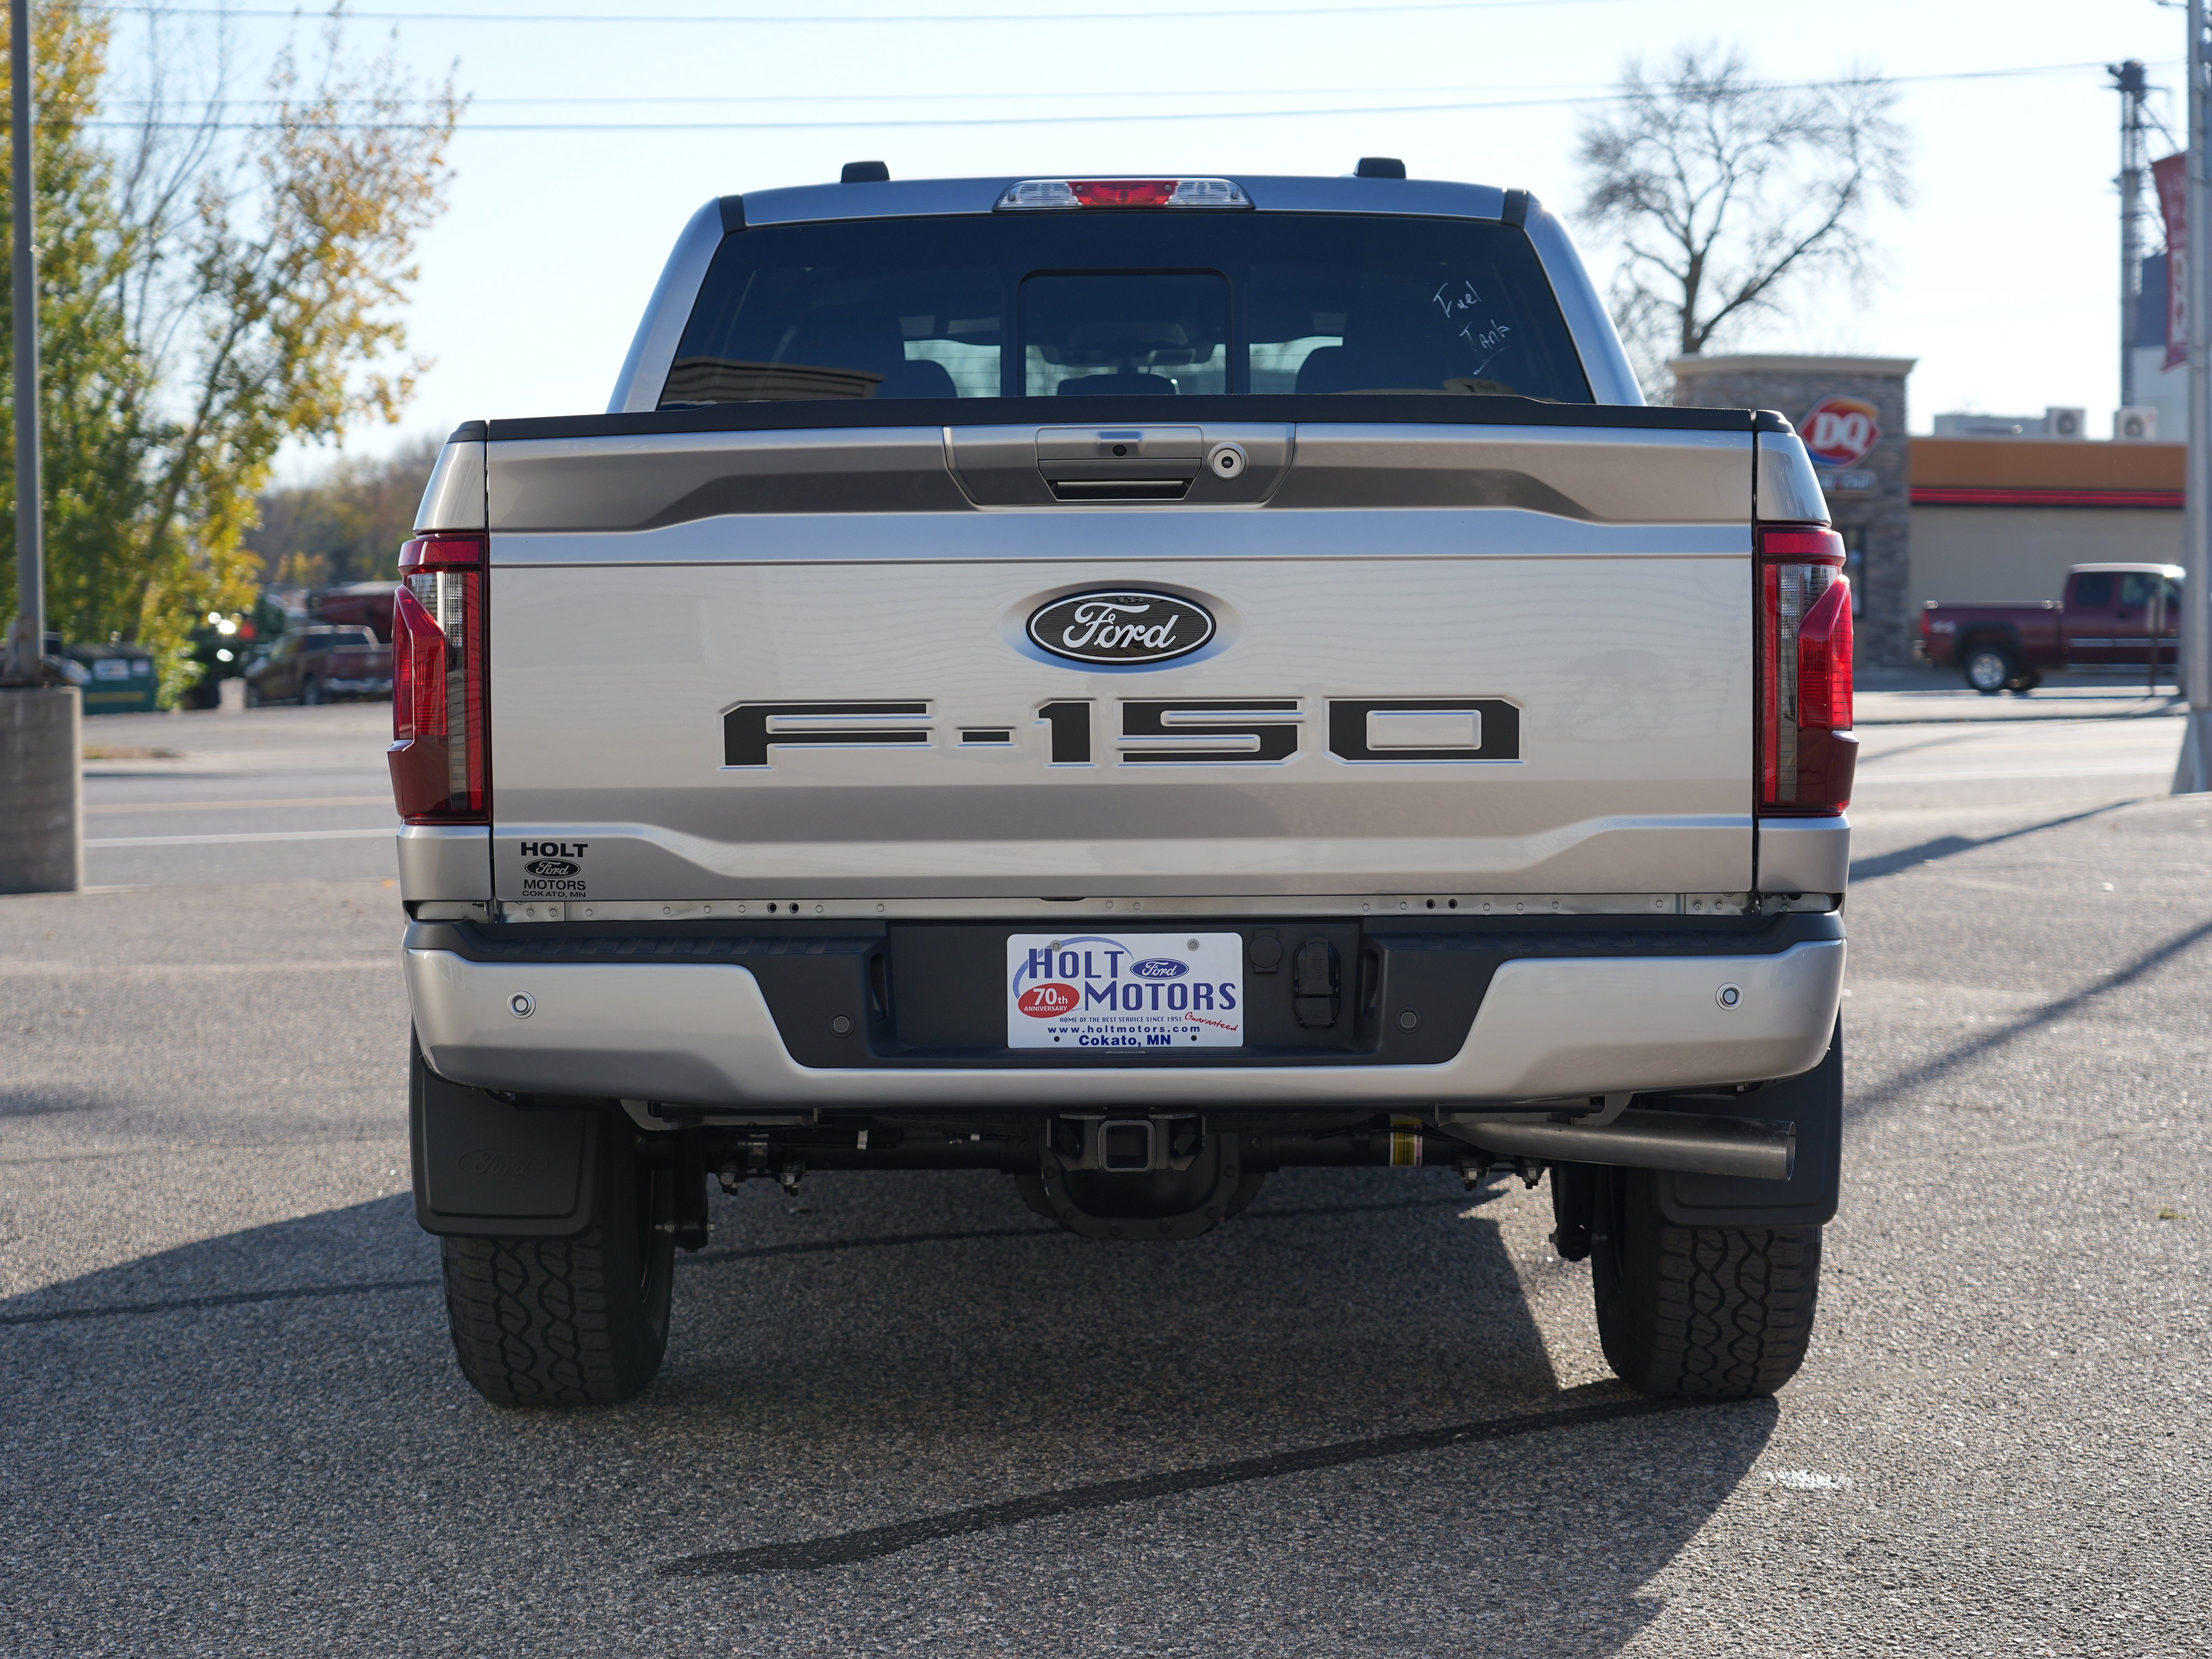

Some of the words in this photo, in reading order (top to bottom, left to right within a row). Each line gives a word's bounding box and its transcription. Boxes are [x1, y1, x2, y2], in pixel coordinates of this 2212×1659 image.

[1433, 280, 1482, 318] Fuel
[1813, 412, 1870, 455] DQ
[1062, 602, 1179, 649] Ford
[722, 698, 1522, 766] F-150
[521, 842, 589, 858] HOLT
[535, 861, 570, 875] Ford
[524, 879, 586, 891] MOTORS
[522, 891, 568, 899] COKATO,
[1028, 948, 1124, 979] HOLT
[1142, 961, 1177, 977] Ford
[1033, 988, 1068, 1006] 70th
[1084, 981, 1236, 1011] MOTORS
[1048, 1025, 1200, 1033] www.holtmotors.com
[1184, 1011, 1238, 1031] Guaranteed
[1078, 1035, 1141, 1047] Cokato,
[1147, 1035, 1171, 1045] MN
[475, 1150, 531, 1175] Ford
